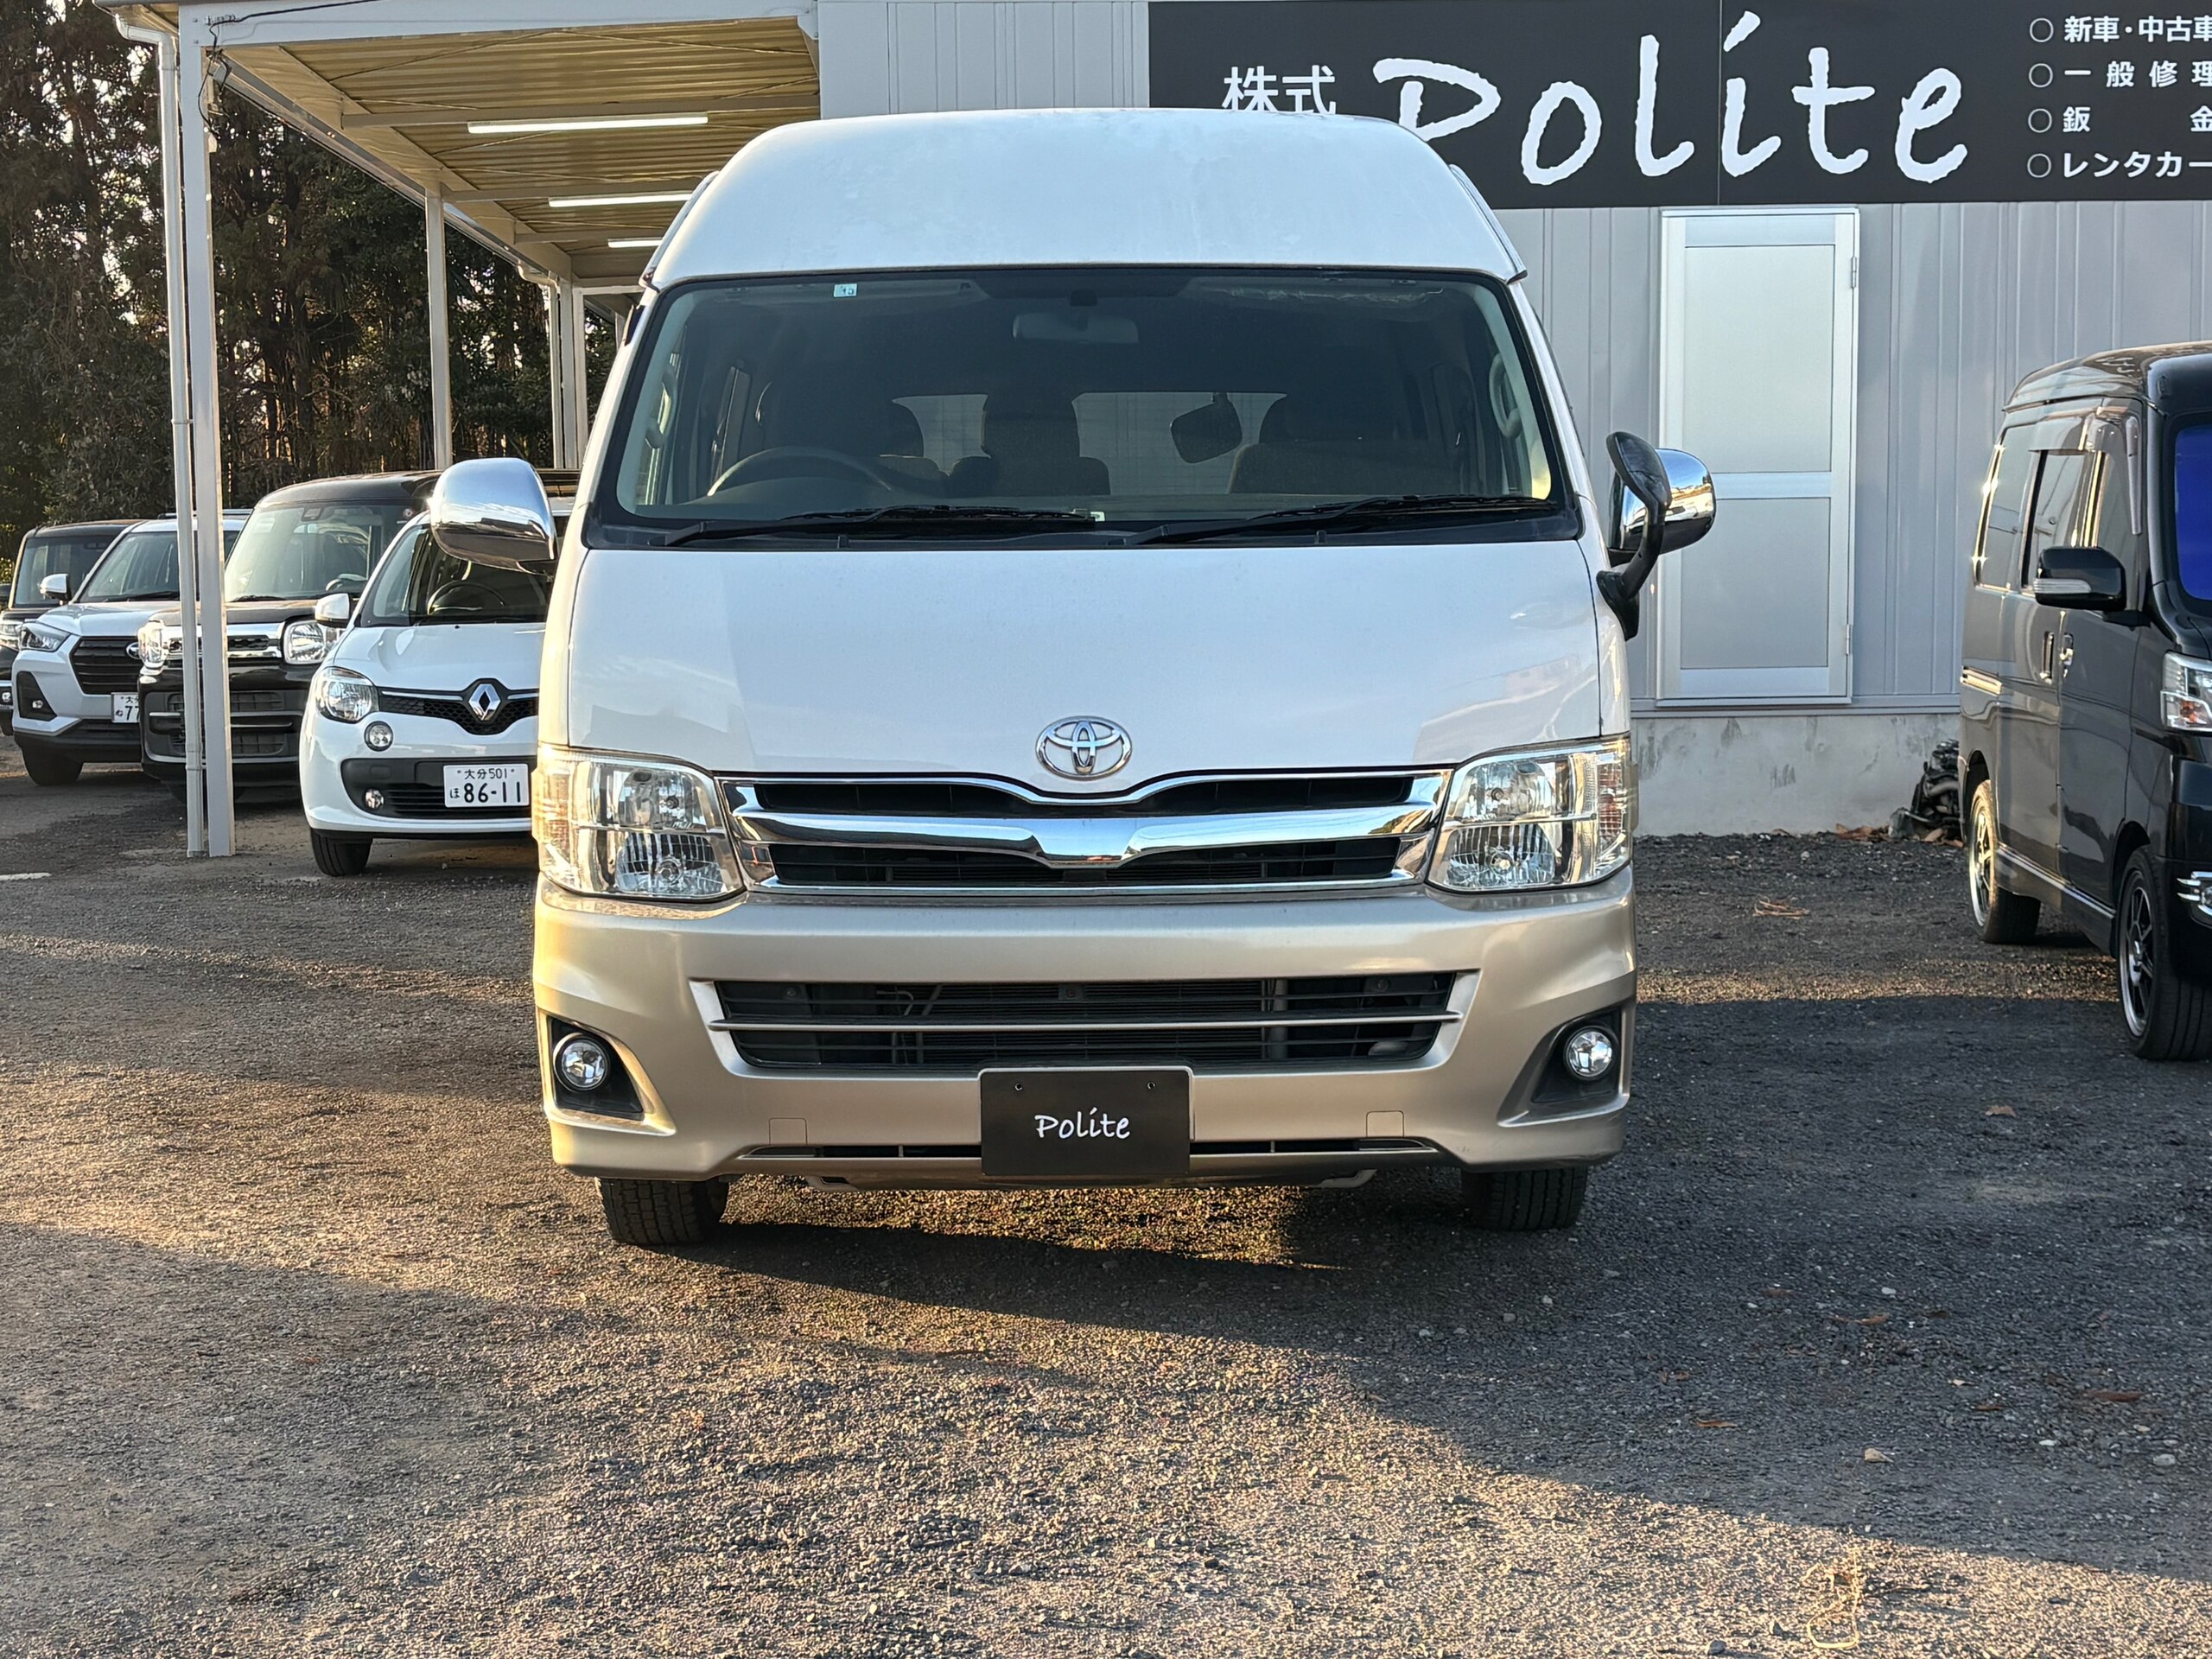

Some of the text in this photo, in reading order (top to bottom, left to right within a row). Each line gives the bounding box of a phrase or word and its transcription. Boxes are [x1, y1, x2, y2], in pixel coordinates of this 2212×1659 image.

[2064, 16, 2212, 42] 新車・中古車
[1221, 65, 1337, 114] 株式
[1373, 10, 1967, 186] Polite
[2063, 151, 2212, 178] レンタカー
[449, 781, 521, 804] ほ 86-11
[1034, 1107, 1130, 1139] Polite
